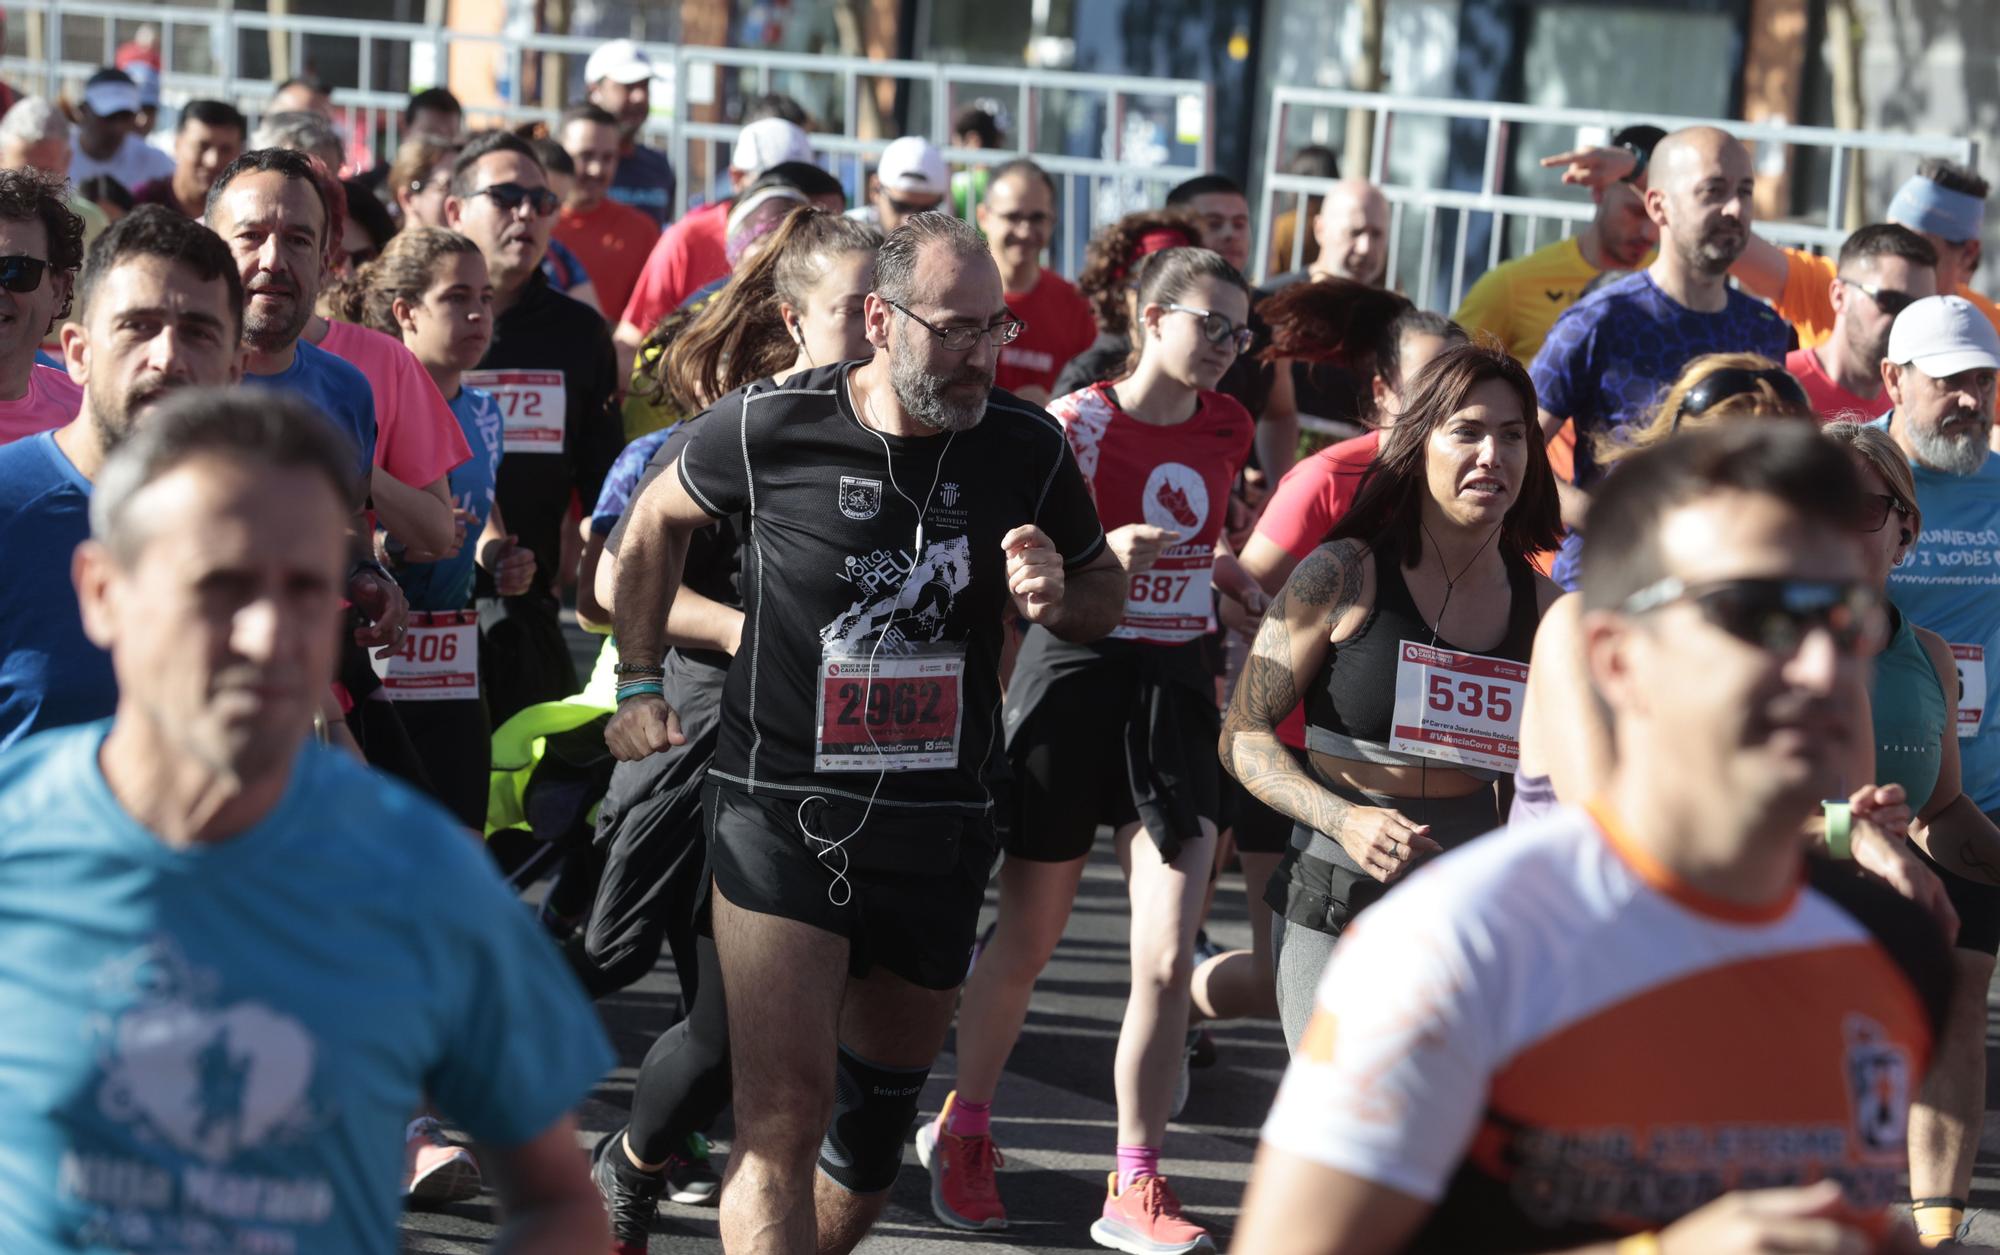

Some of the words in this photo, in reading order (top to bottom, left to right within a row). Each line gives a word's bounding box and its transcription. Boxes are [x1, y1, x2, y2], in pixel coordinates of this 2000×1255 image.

[836, 549, 885, 583] Volta
[862, 549, 914, 593] PEU
[1936, 549, 1993, 566] RODES
[856, 580, 875, 597] 2022
[837, 682, 942, 726] 2962
[1428, 674, 1513, 723] 535
[1429, 720, 1454, 730] Carrera
